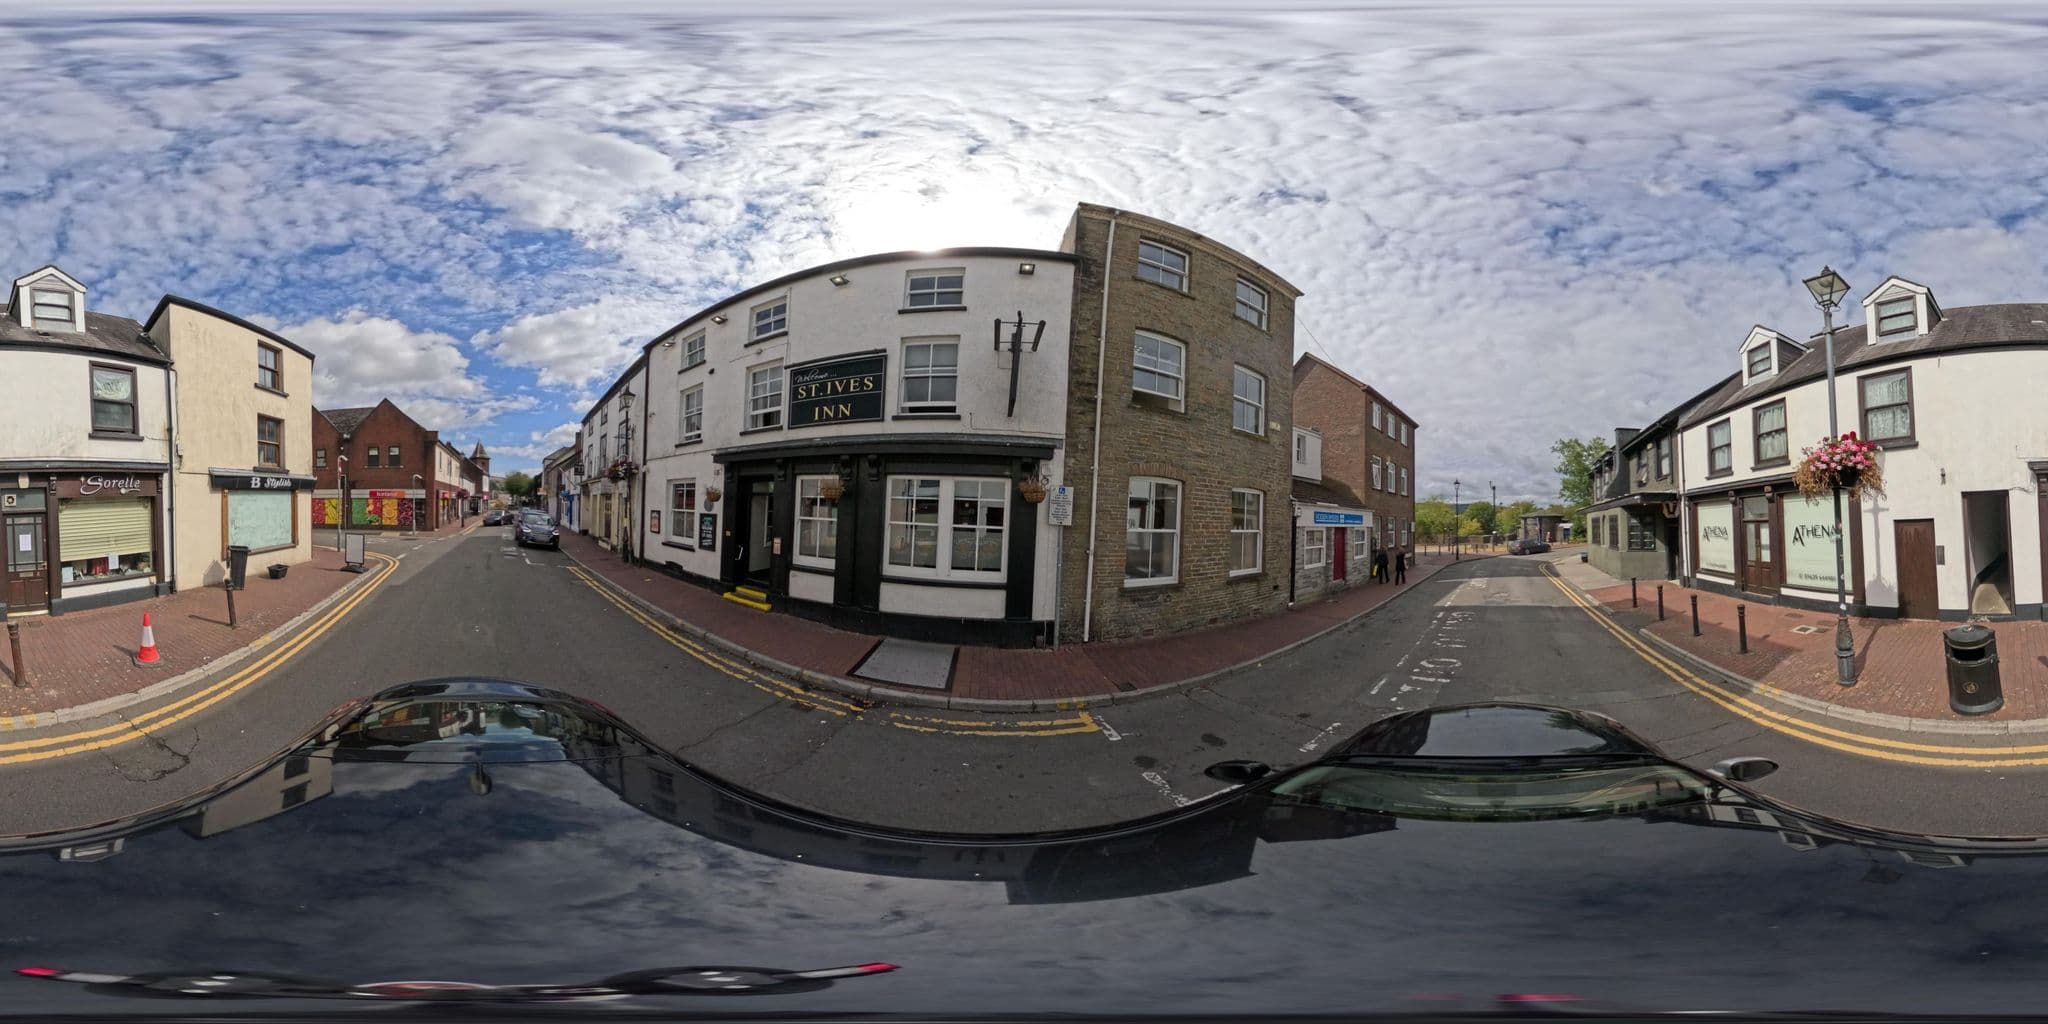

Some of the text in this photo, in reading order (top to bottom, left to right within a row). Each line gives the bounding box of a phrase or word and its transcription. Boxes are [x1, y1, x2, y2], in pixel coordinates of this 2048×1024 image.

[814, 403, 851, 420] INN
[80, 475, 141, 495] Sorelle
[264, 477, 292, 489] Stylish
